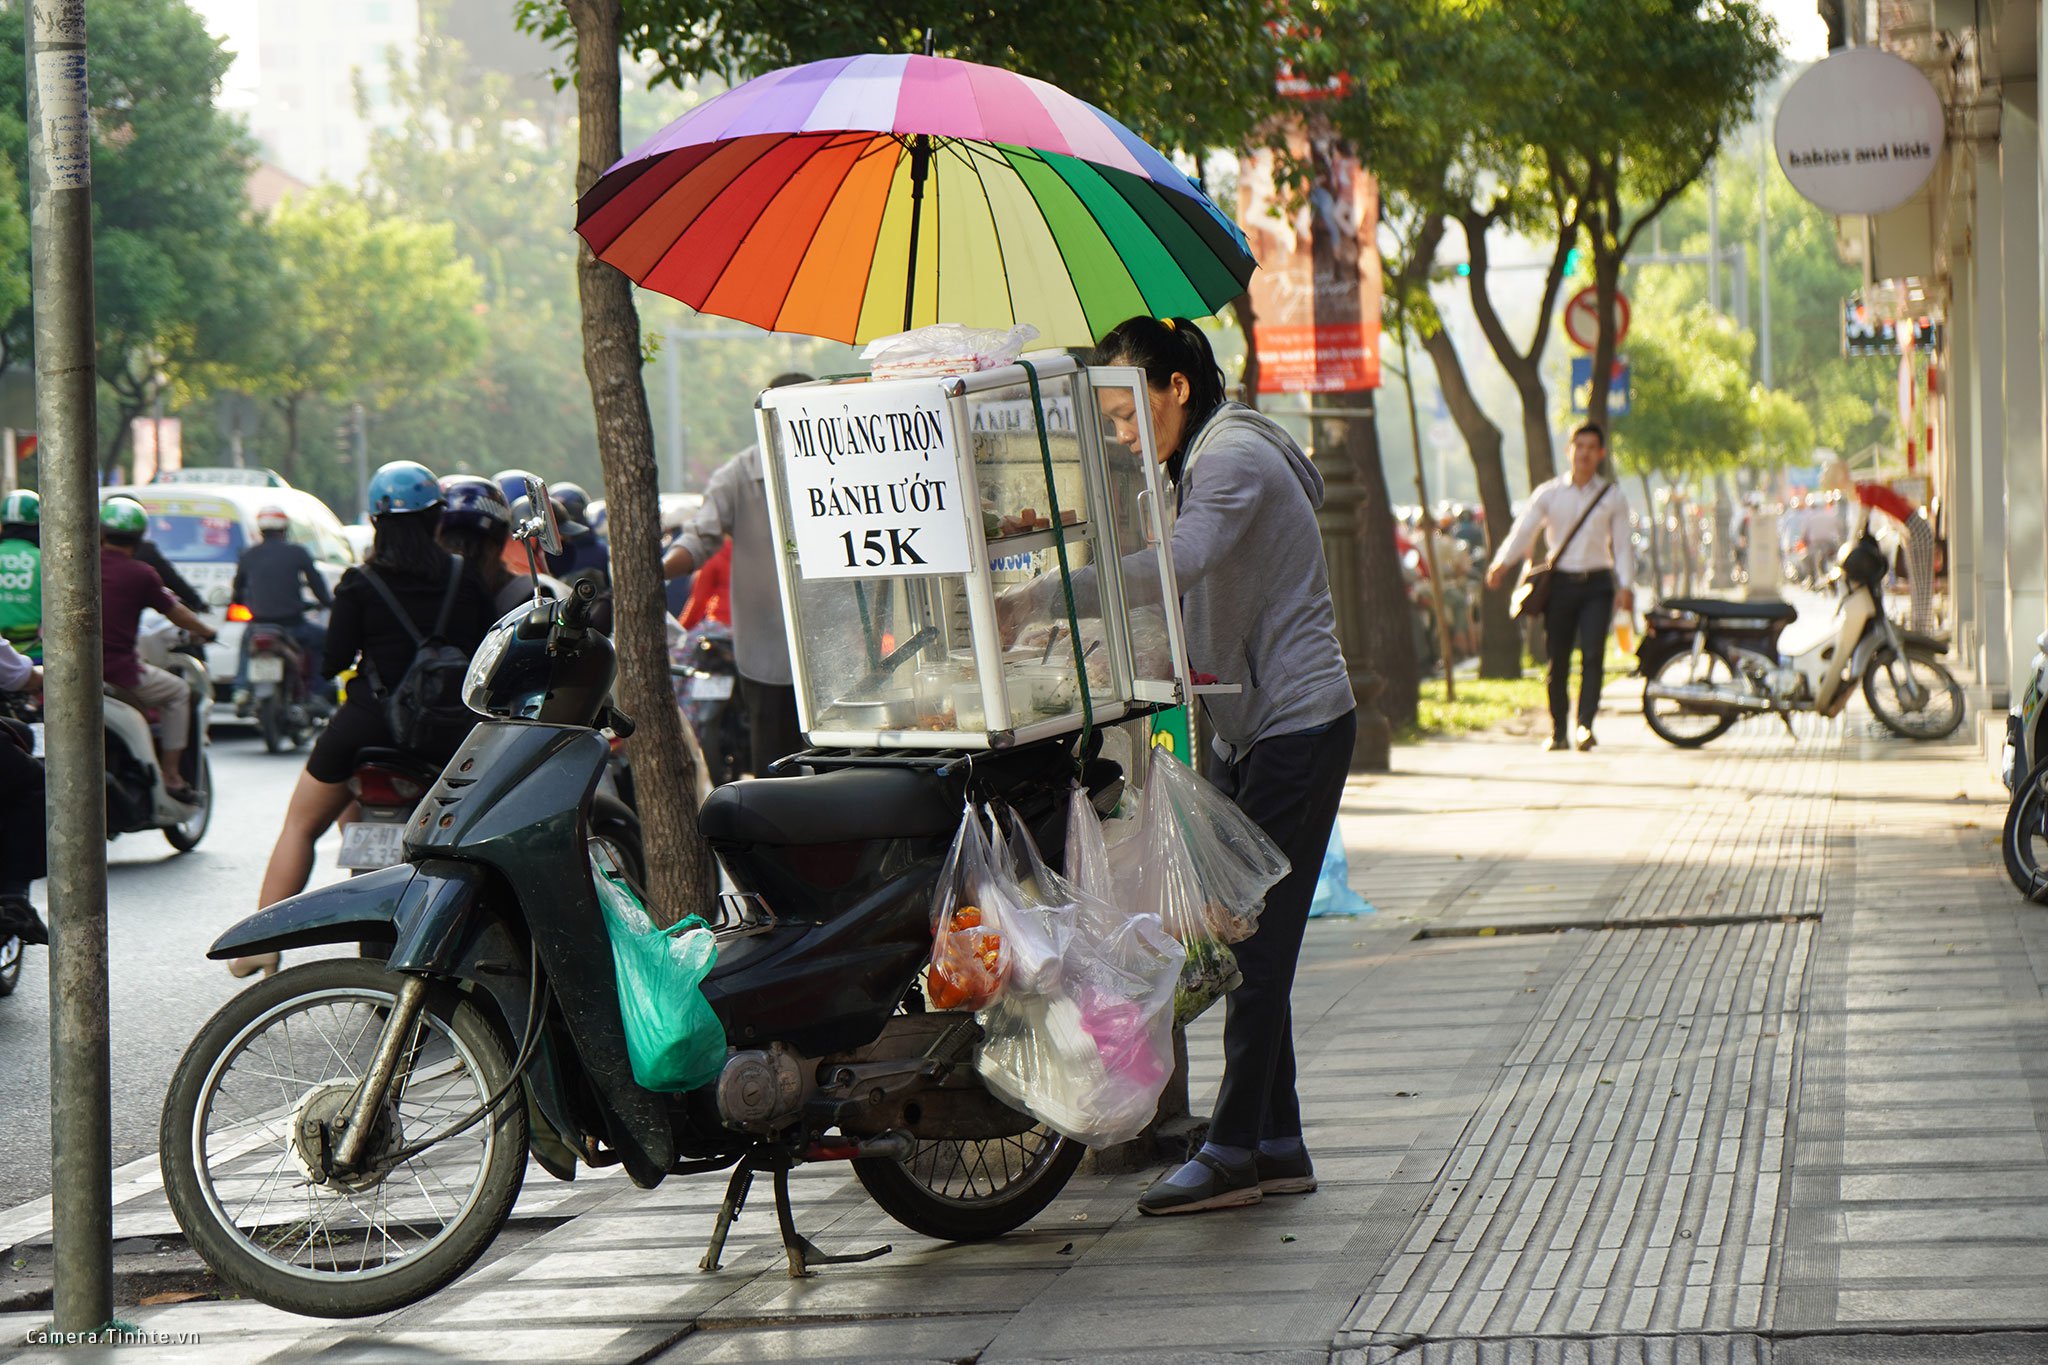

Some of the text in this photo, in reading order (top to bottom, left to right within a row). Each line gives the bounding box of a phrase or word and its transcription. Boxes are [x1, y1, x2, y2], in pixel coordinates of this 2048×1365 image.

[1789, 140, 1931, 167] babies and kids
[788, 407, 817, 457] MÌ
[817, 404, 887, 465] QUẢNG
[886, 404, 945, 461] TRỘN
[808, 473, 947, 517] BÁNH ƯỚT
[839, 528, 928, 567] 15K
[0, 569, 33, 590] od
